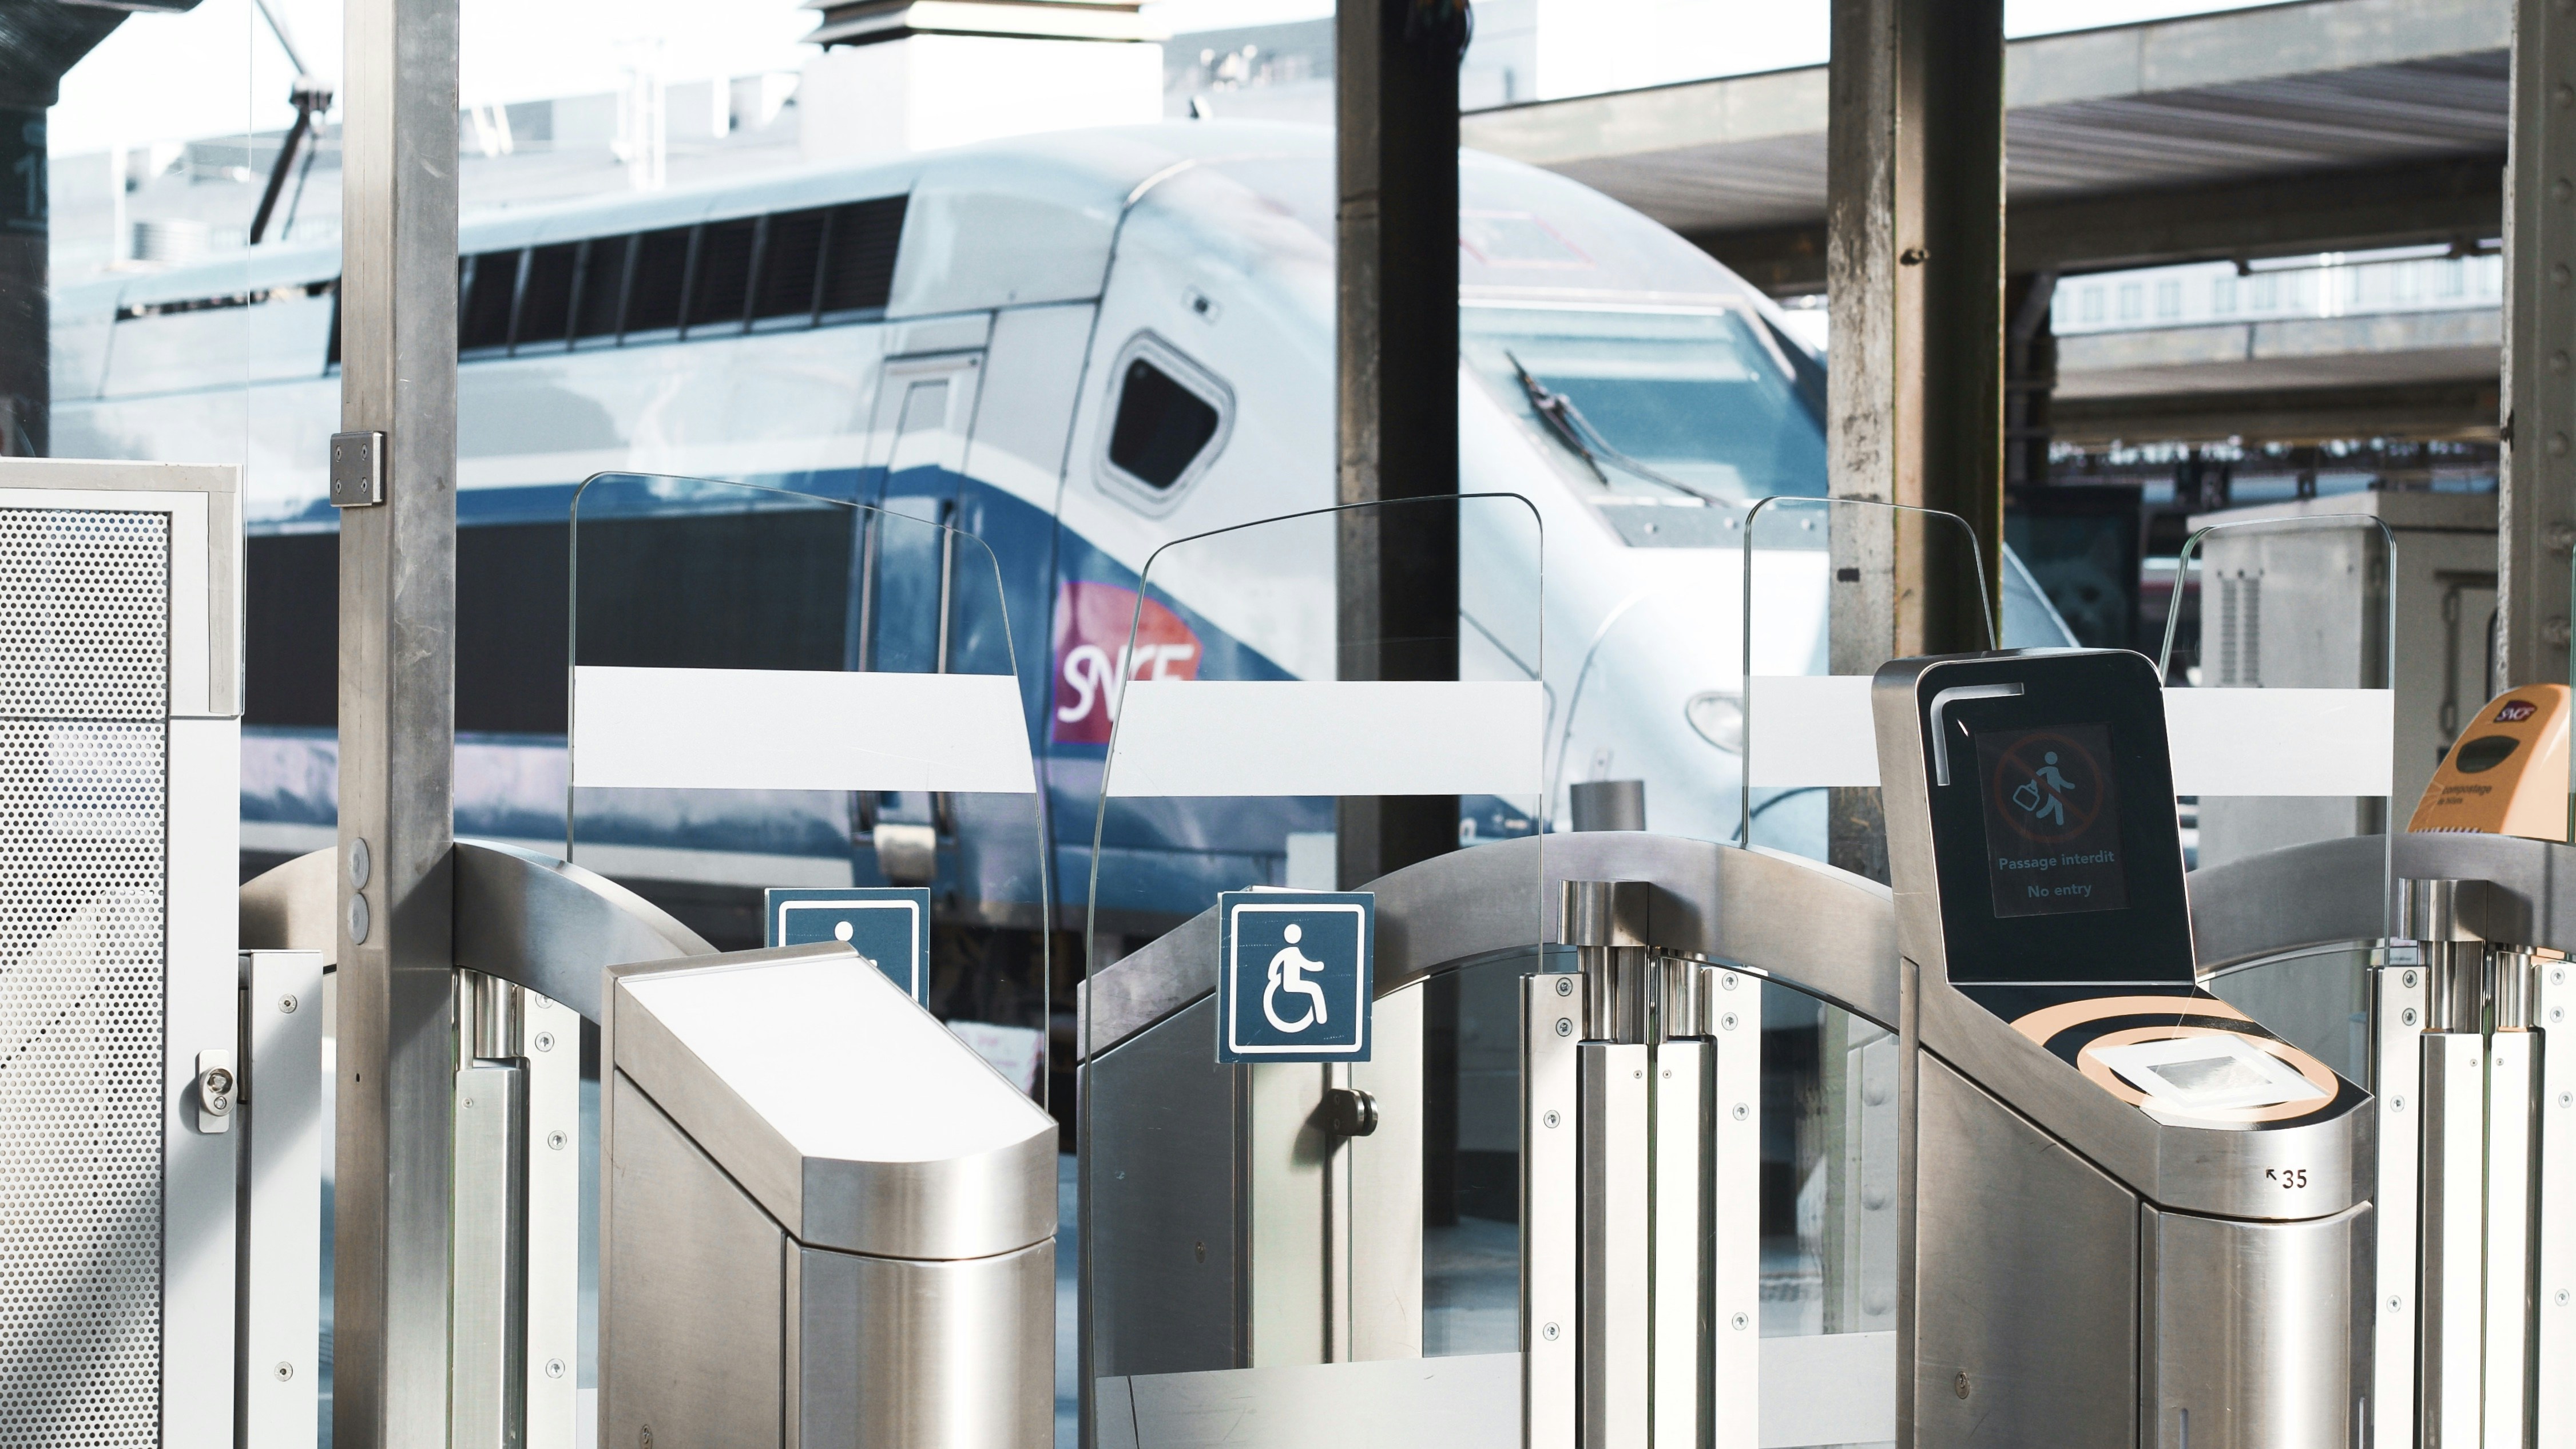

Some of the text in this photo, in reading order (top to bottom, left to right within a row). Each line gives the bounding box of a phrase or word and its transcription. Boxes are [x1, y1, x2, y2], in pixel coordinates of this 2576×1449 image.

[1999, 850, 2115, 871] Passage interdit
[2028, 883, 2092, 898] No entry
[2282, 1169, 2307, 1189] 35
